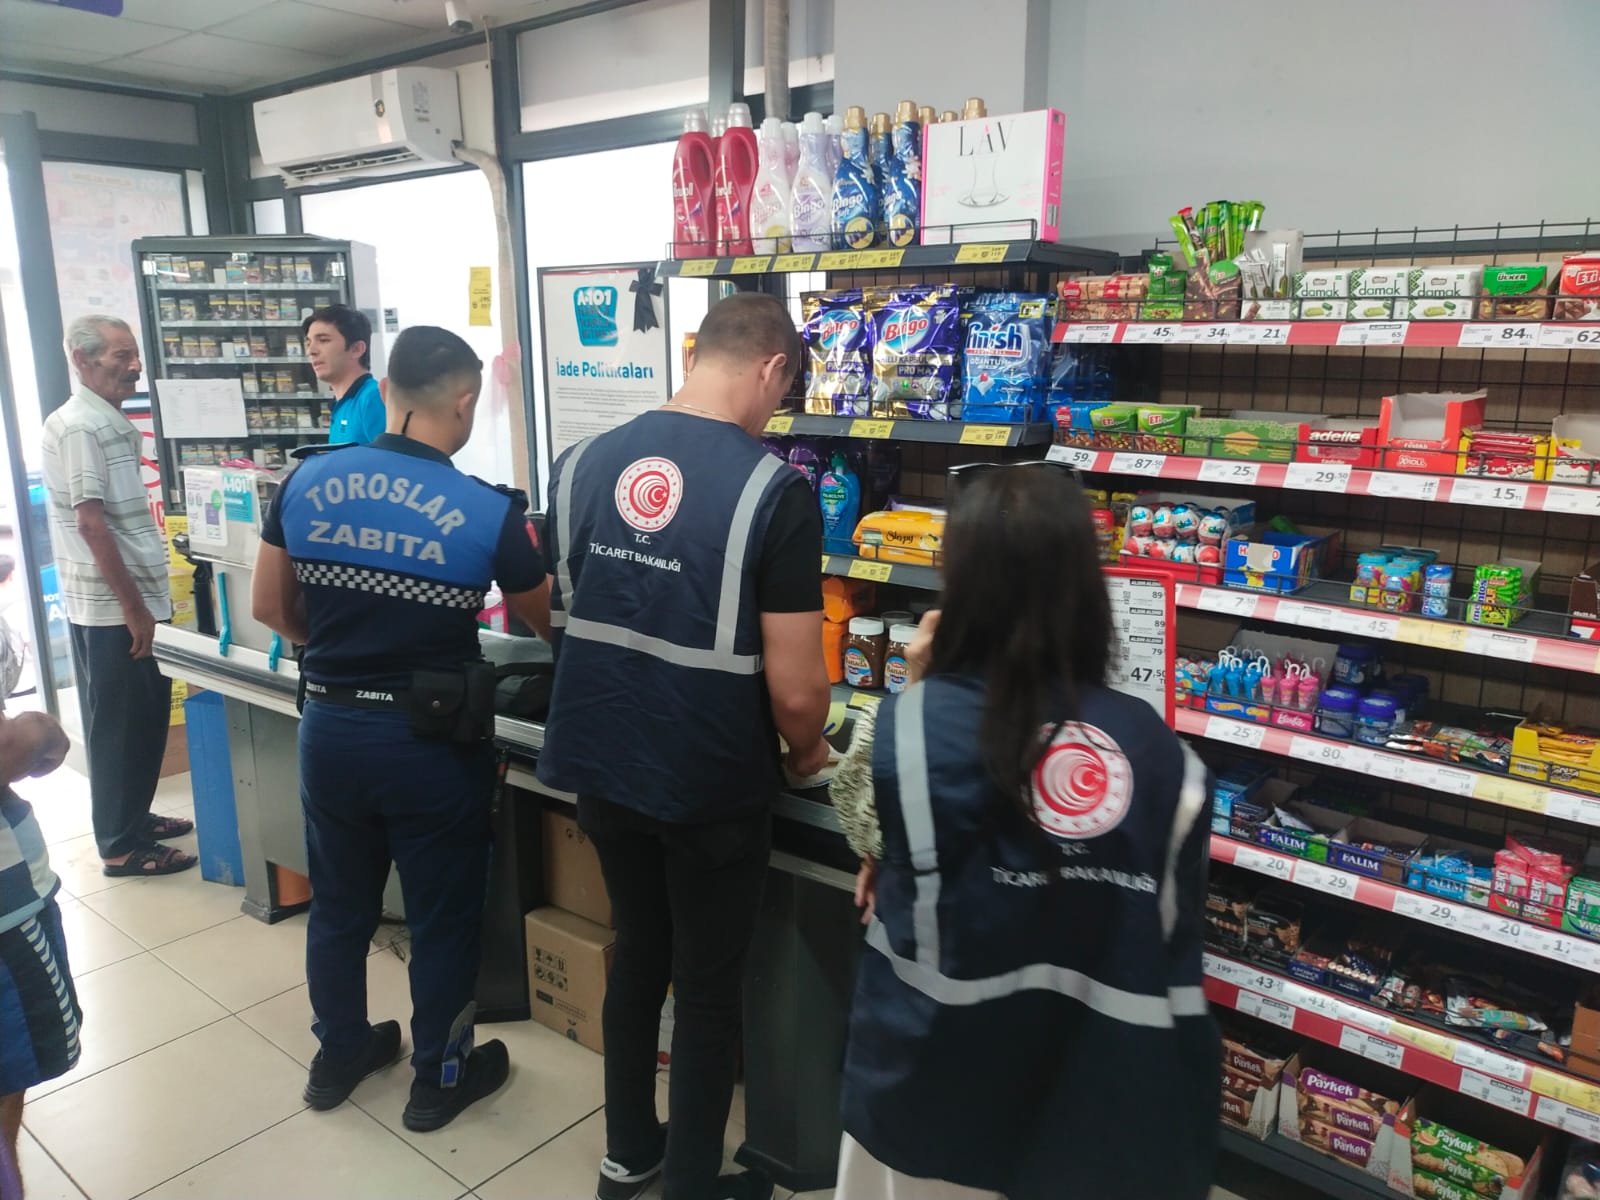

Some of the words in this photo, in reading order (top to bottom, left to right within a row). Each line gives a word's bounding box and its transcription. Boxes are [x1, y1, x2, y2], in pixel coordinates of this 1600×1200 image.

[959, 119, 1016, 156] LAV
[794, 200, 825, 219] Bingo
[832, 194, 864, 211] Bingo
[1301, 281, 1340, 297] damak
[1358, 279, 1401, 296] damak
[1417, 281, 1461, 297] damak
[821, 318, 859, 341] Bingo
[884, 317, 928, 341] Bingo
[966, 321, 1022, 351] finish
[1153, 327, 1170, 337] 45
[1207, 327, 1226, 338] 34
[1262, 328, 1281, 338] 21
[1501, 327, 1526, 339] 84
[556, 357, 580, 378] İade
[582, 361, 654, 380] Politikaları
[1072, 452, 1089, 463] 59
[1232, 465, 1251, 476] 25
[1492, 487, 1516, 500] 15
[304, 472, 467, 537] TOROSLAR
[306, 519, 446, 566] ZABITA
[589, 541, 635, 561] TİCARET
[635, 552, 682, 573] BAKANLIĞI
[1152, 591, 1163, 599] 89
[1154, 620, 1165, 628] 89
[1152, 647, 1163, 656] 79
[887, 664, 908, 676] Banad
[355, 690, 394, 702] ZABITA
[1270, 832, 1306, 850] FALIM
[1266, 857, 1285, 870] 20
[1342, 853, 1380, 872] FALIM
[1327, 874, 1347, 889] 29
[1430, 903, 1451, 919] 29
[1497, 920, 1521, 937] 20
[1255, 975, 1274, 989] 43
[1233, 1054, 1262, 1074] Paykek
[1306, 1073, 1354, 1097] Paykek
[1336, 1112, 1370, 1132] Paykek
[1333, 1137, 1367, 1158] Paykek
[1436, 1128, 1474, 1154] Paykek
[1442, 1157, 1474, 1180] Paykek
